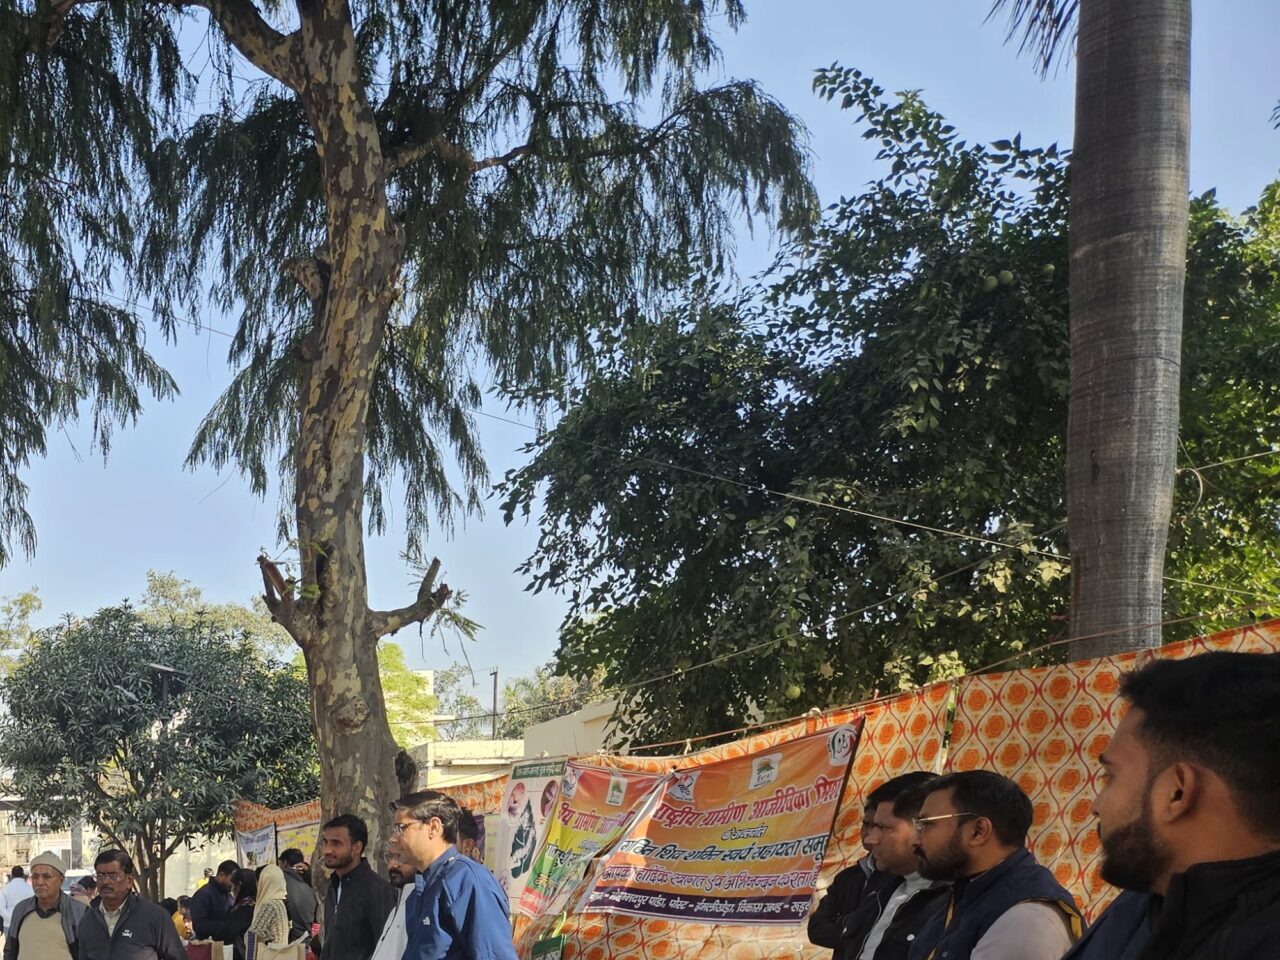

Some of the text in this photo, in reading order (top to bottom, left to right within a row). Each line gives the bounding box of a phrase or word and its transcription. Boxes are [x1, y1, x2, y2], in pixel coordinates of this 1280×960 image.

[652, 802, 703, 828] राष्ट्रीय
[699, 800, 748, 827] ग्रामीण
[748, 786, 811, 820] आजीविका
[721, 842, 757, 861] स्वयं
[752, 840, 801, 860] सहायता
[635, 865, 670, 885] हार्दिक
[670, 873, 707, 888] स्वागत
[776, 871, 810, 888] करता
[668, 896, 690, 910] पोस्ट
[737, 899, 764, 913] विकास
